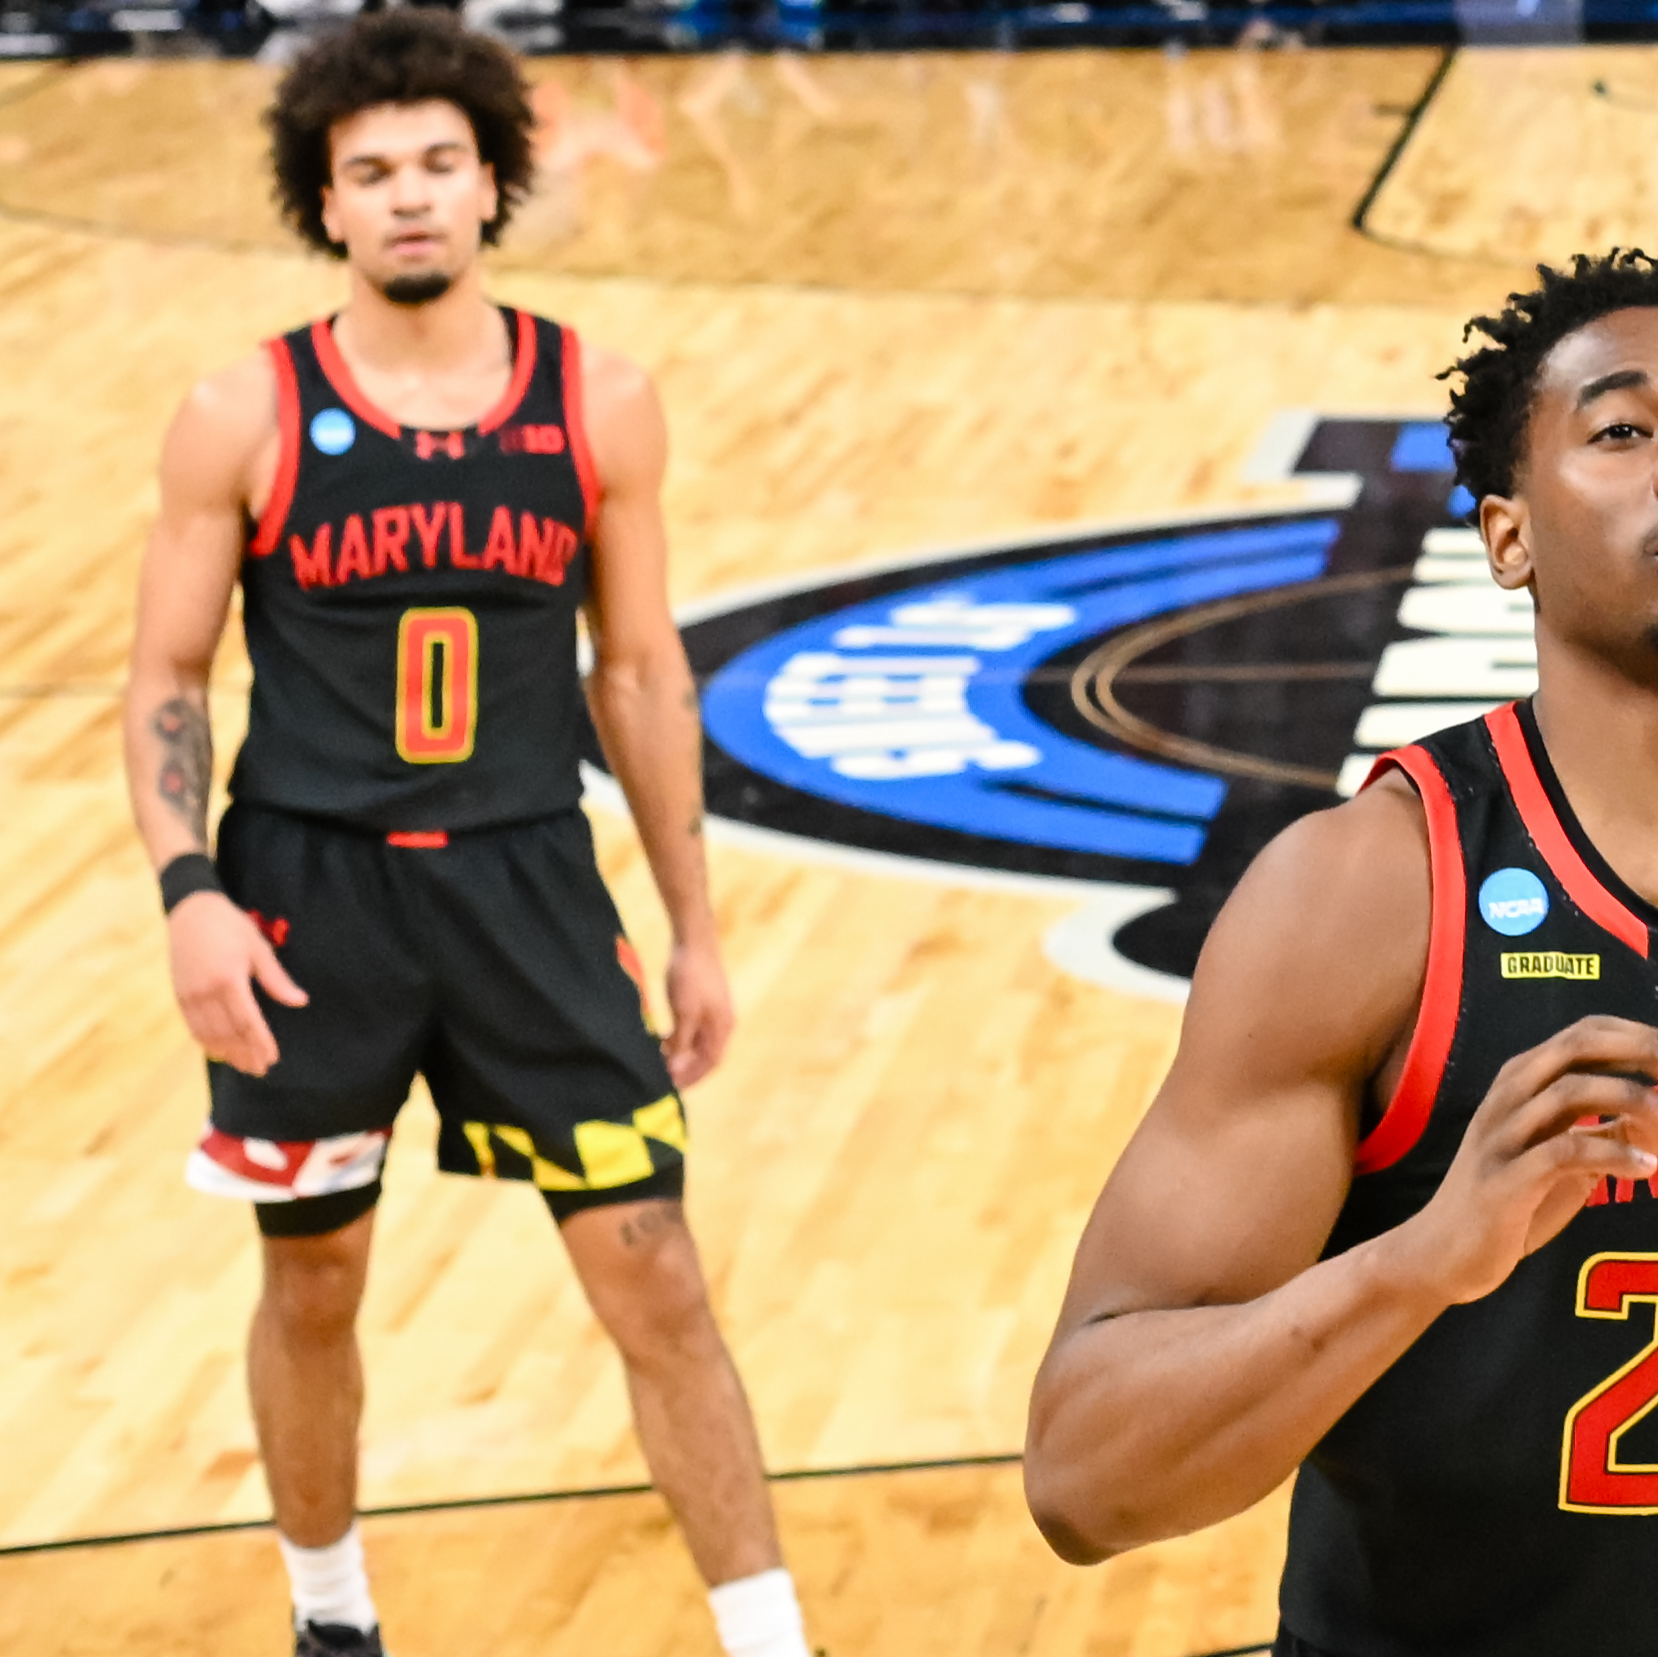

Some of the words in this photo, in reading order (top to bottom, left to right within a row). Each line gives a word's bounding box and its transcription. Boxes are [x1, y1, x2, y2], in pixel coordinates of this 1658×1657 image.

[288, 502, 577, 590] MARYLAND
[396, 606, 479, 764] 0
[1507, 953, 1595, 976] GRADUATE
